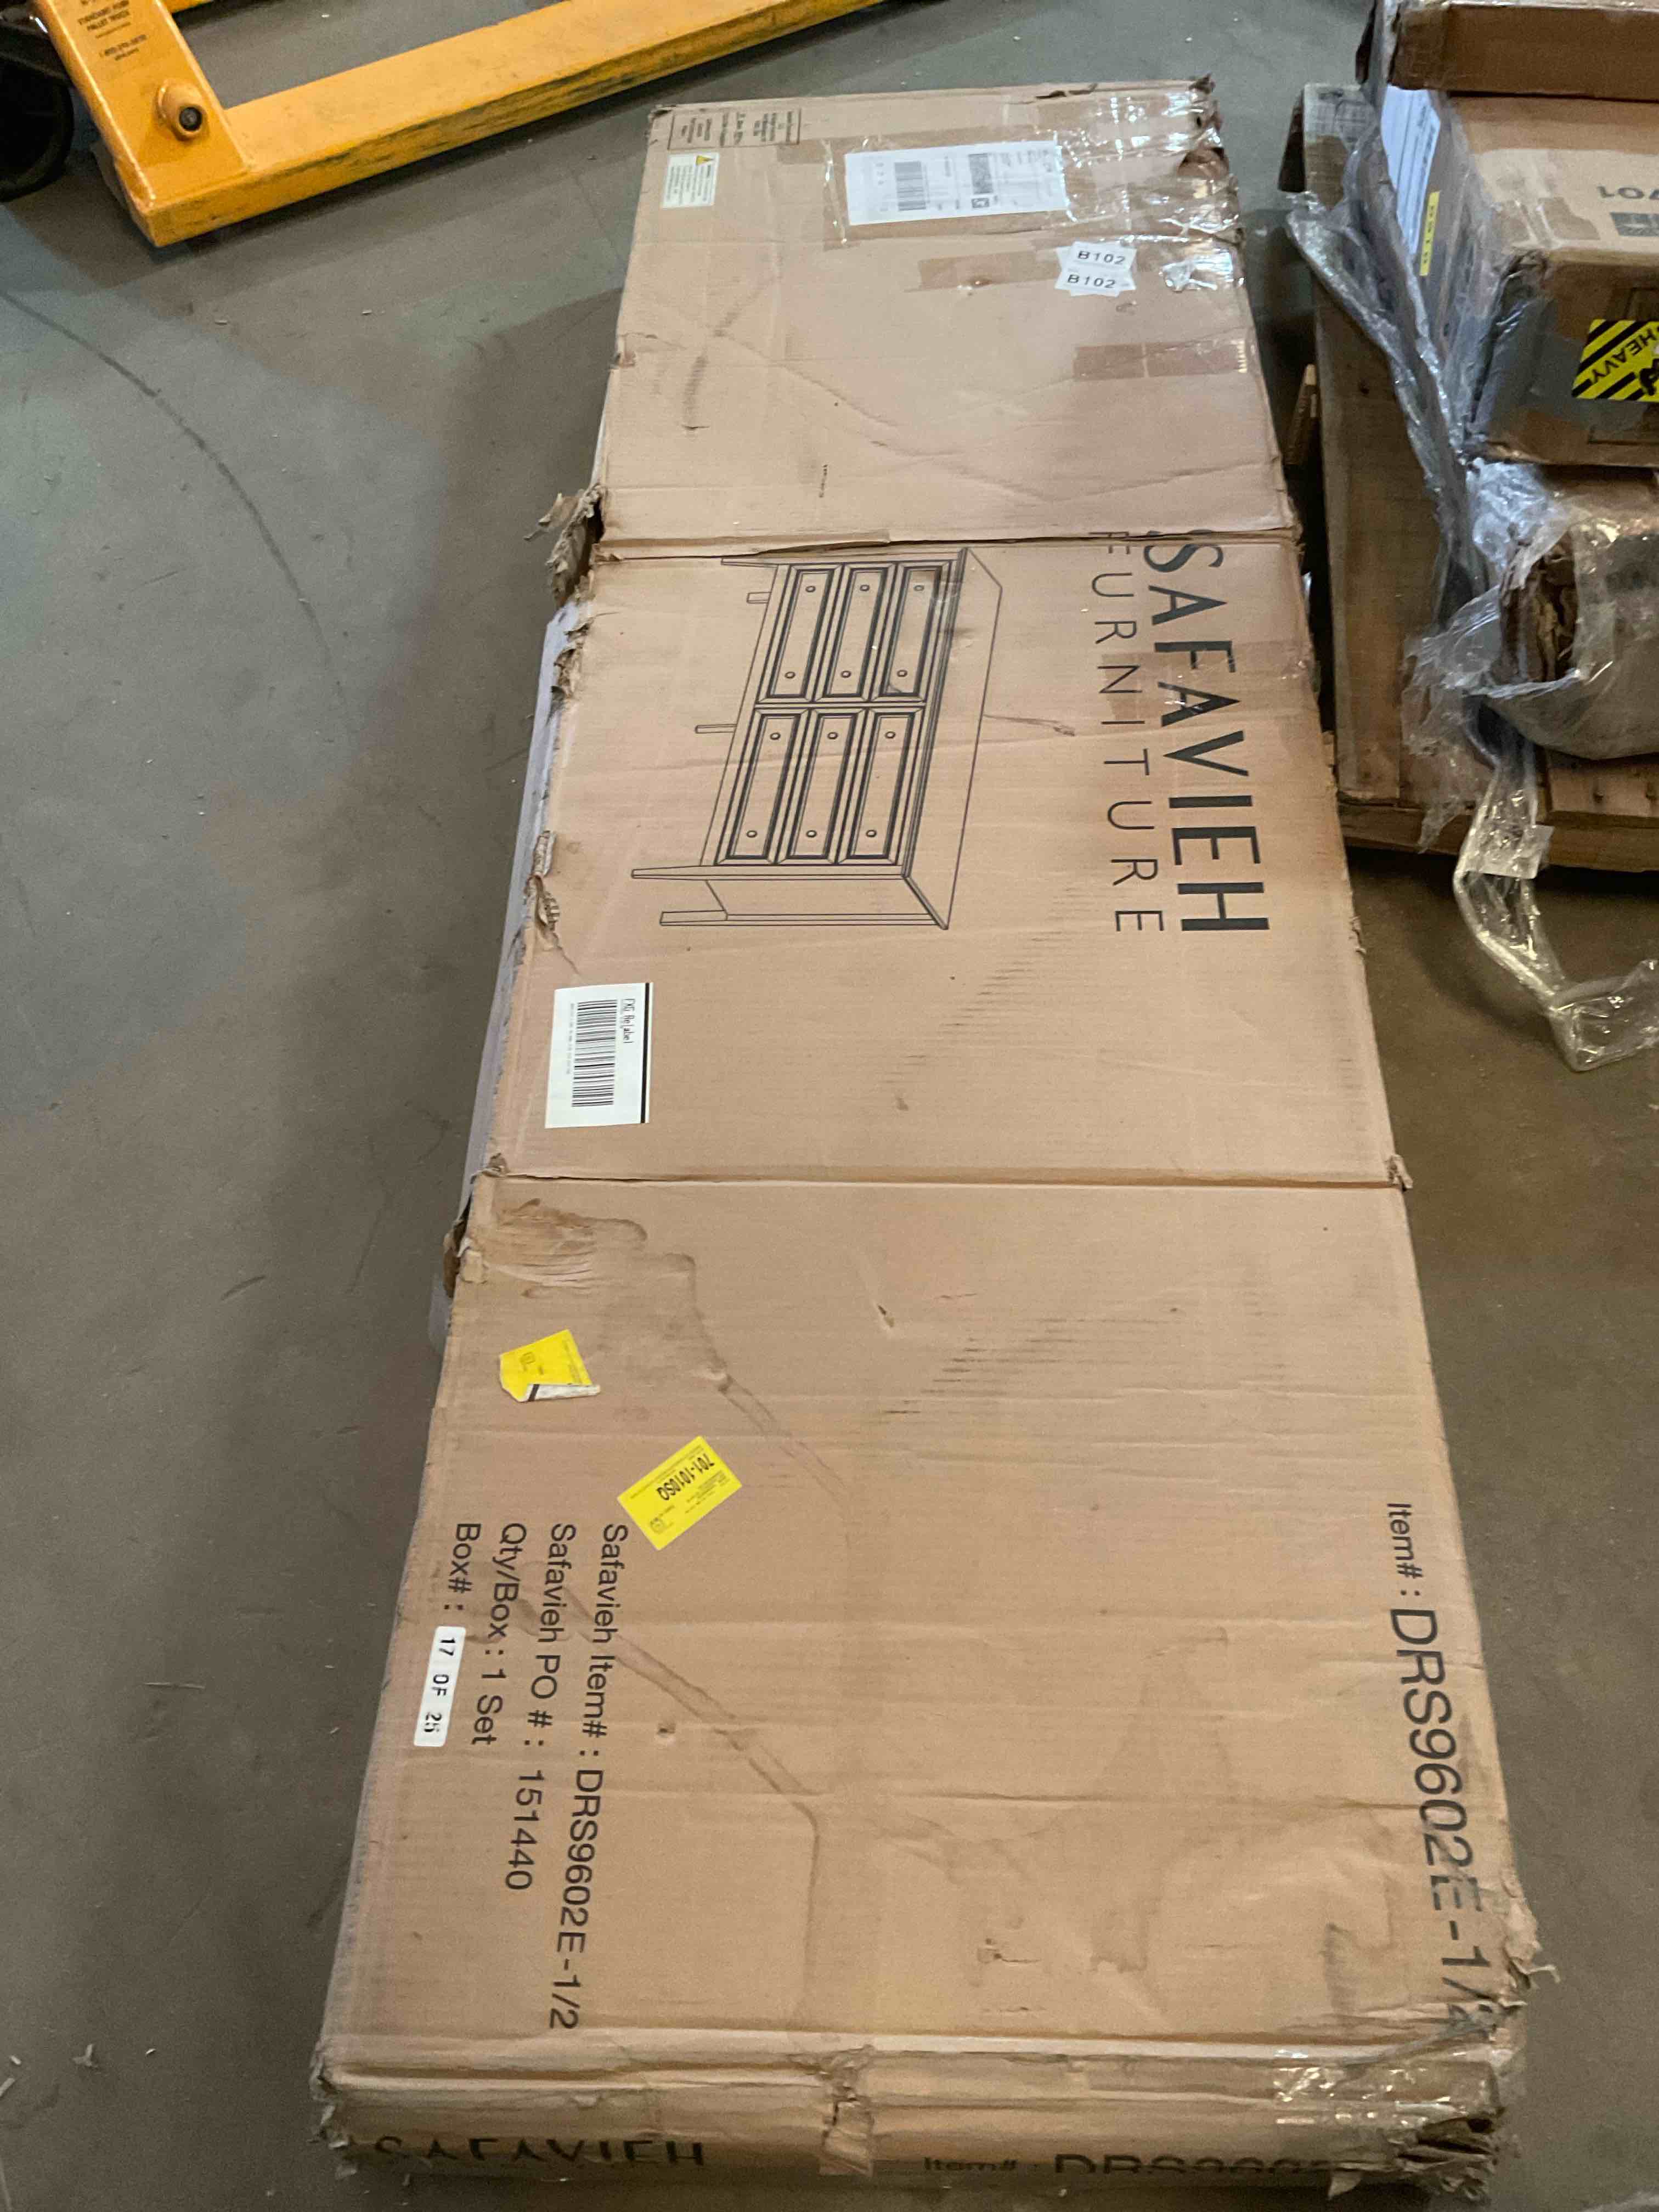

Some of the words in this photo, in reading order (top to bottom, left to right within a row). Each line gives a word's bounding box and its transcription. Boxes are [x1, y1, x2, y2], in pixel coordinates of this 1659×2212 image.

[1067, 274, 1116, 289] B102
[1077, 250, 1126, 265] B102
[1592, 328, 1656, 383] HEAVY
[1089, 532, 1164, 932] FURNITURE
[1144, 529, 1270, 931] SAFAVIEH
[448, 1523, 482, 1594] Box#
[1386, 1503, 1423, 1579] Item#
[488, 1523, 527, 1639] Qty/Box
[538, 1523, 577, 1643] Safavieh
[592, 1523, 629, 1644] Safavieh
[437, 1637, 456, 1657] 17
[481, 1669, 506, 1679] 1
[531, 1654, 561, 1700] PO
[432, 1673, 449, 1697] OF
[472, 1694, 504, 1746] Set
[582, 1655, 616, 1739] Item#
[505, 1770, 545, 1891] 151440
[549, 1770, 604, 2029] DRS9602E-1/2
